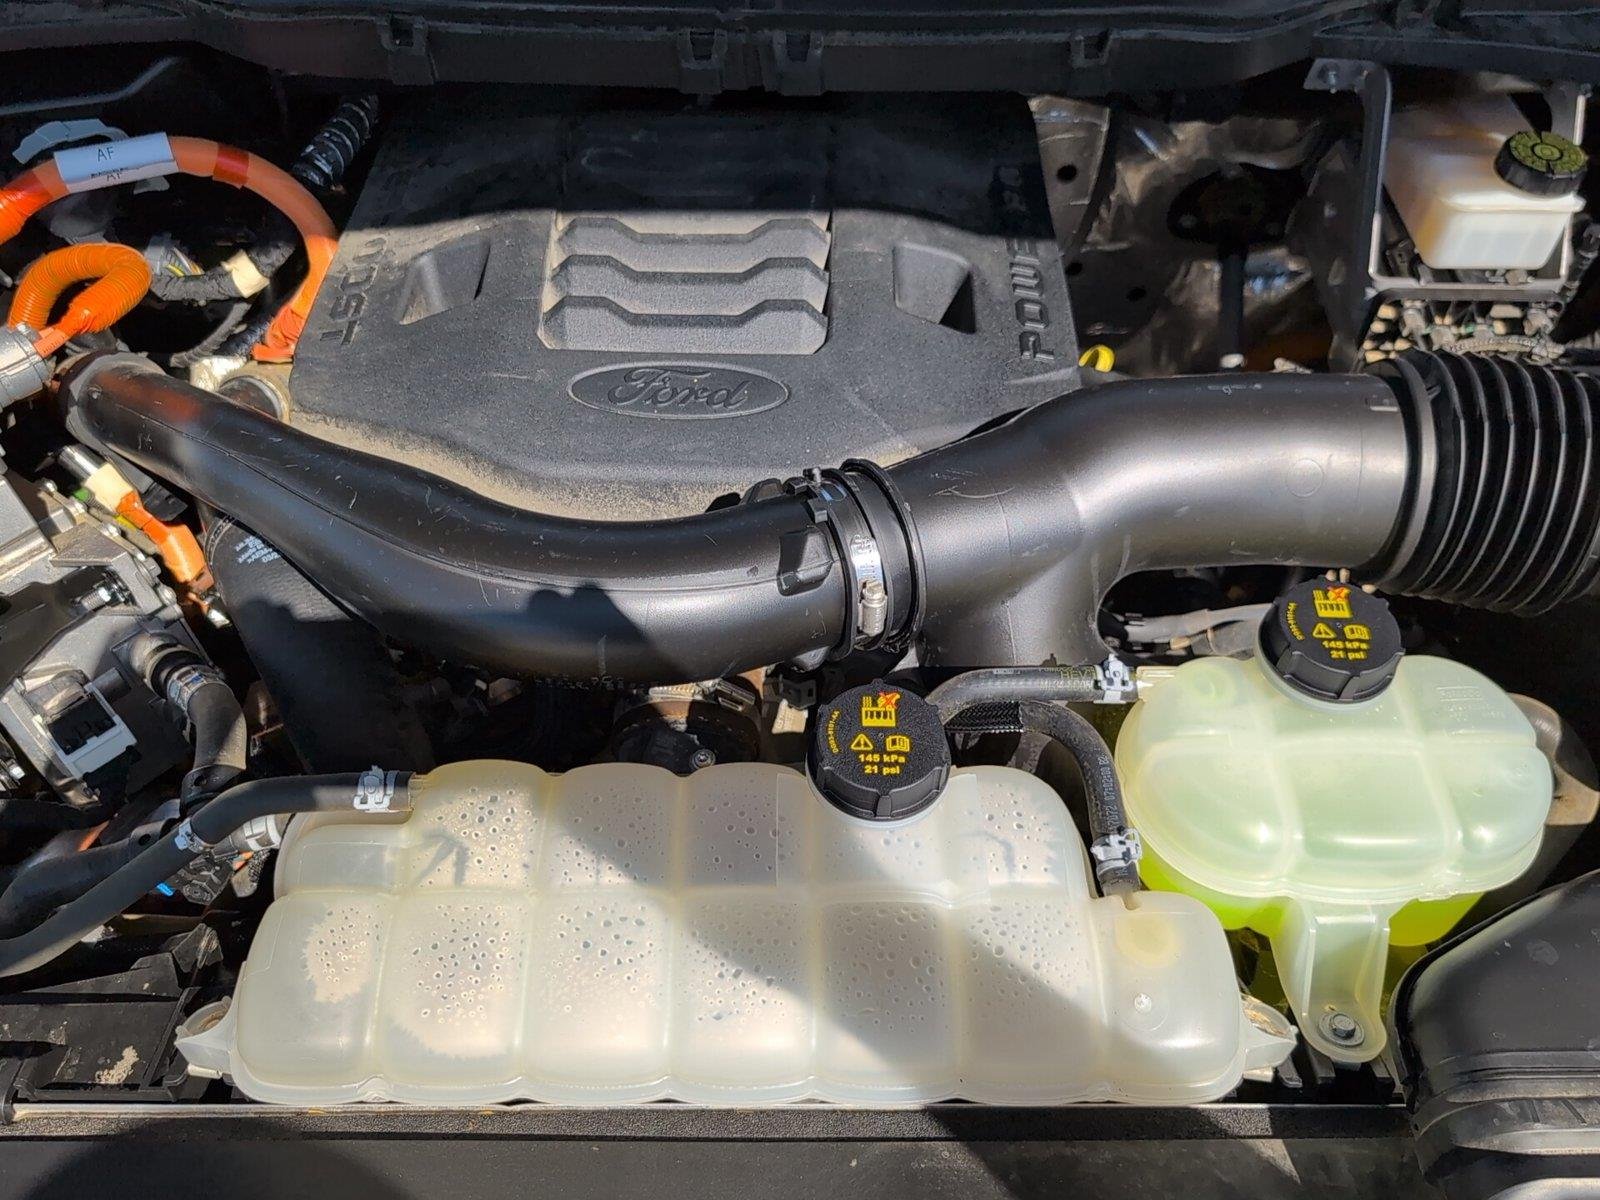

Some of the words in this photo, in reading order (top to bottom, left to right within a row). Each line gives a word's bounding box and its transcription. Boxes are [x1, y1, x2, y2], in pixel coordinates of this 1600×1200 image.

[96, 146, 116, 162] AF
[607, 367, 753, 410] Ford
[1322, 640, 1344, 650] 145
[1345, 640, 1370, 651] kPa
[1330, 651, 1345, 660] 21
[1347, 652, 1367, 661] psi
[859, 754, 880, 763] 145
[883, 754, 906, 763] kPa
[864, 765, 879, 774] 21
[882, 766, 900, 776] psi
